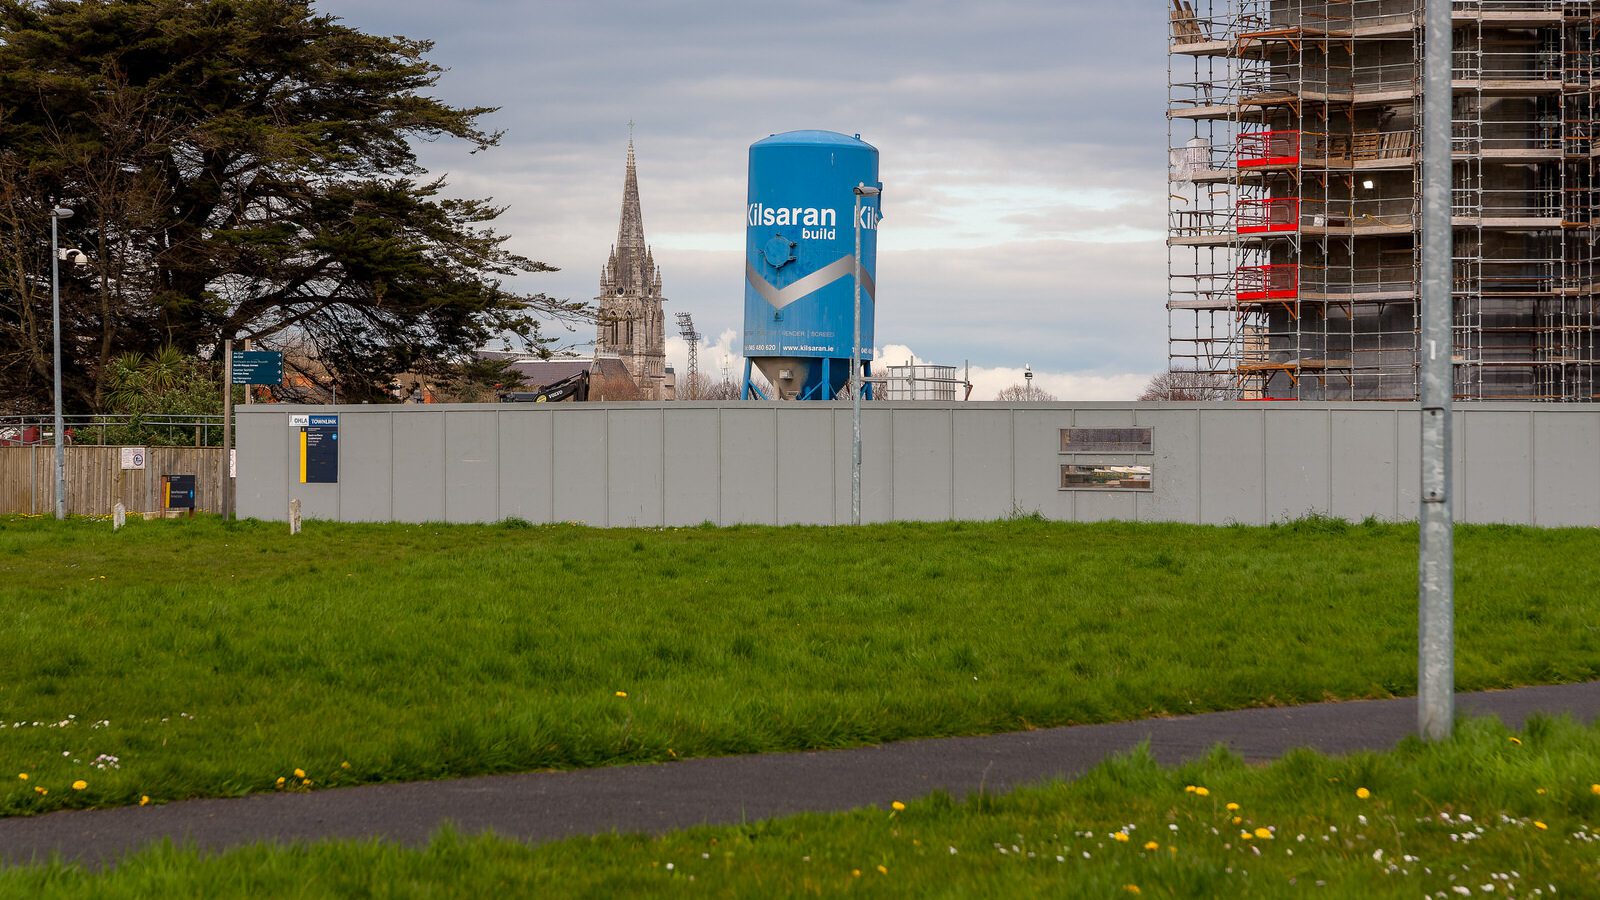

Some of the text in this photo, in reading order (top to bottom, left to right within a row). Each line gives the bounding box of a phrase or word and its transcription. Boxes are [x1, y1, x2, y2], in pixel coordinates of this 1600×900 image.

[748, 203, 836, 227] Kilsaran
[802, 228, 836, 240] build
[782, 344, 834, 352] www.kilsaran.ie
